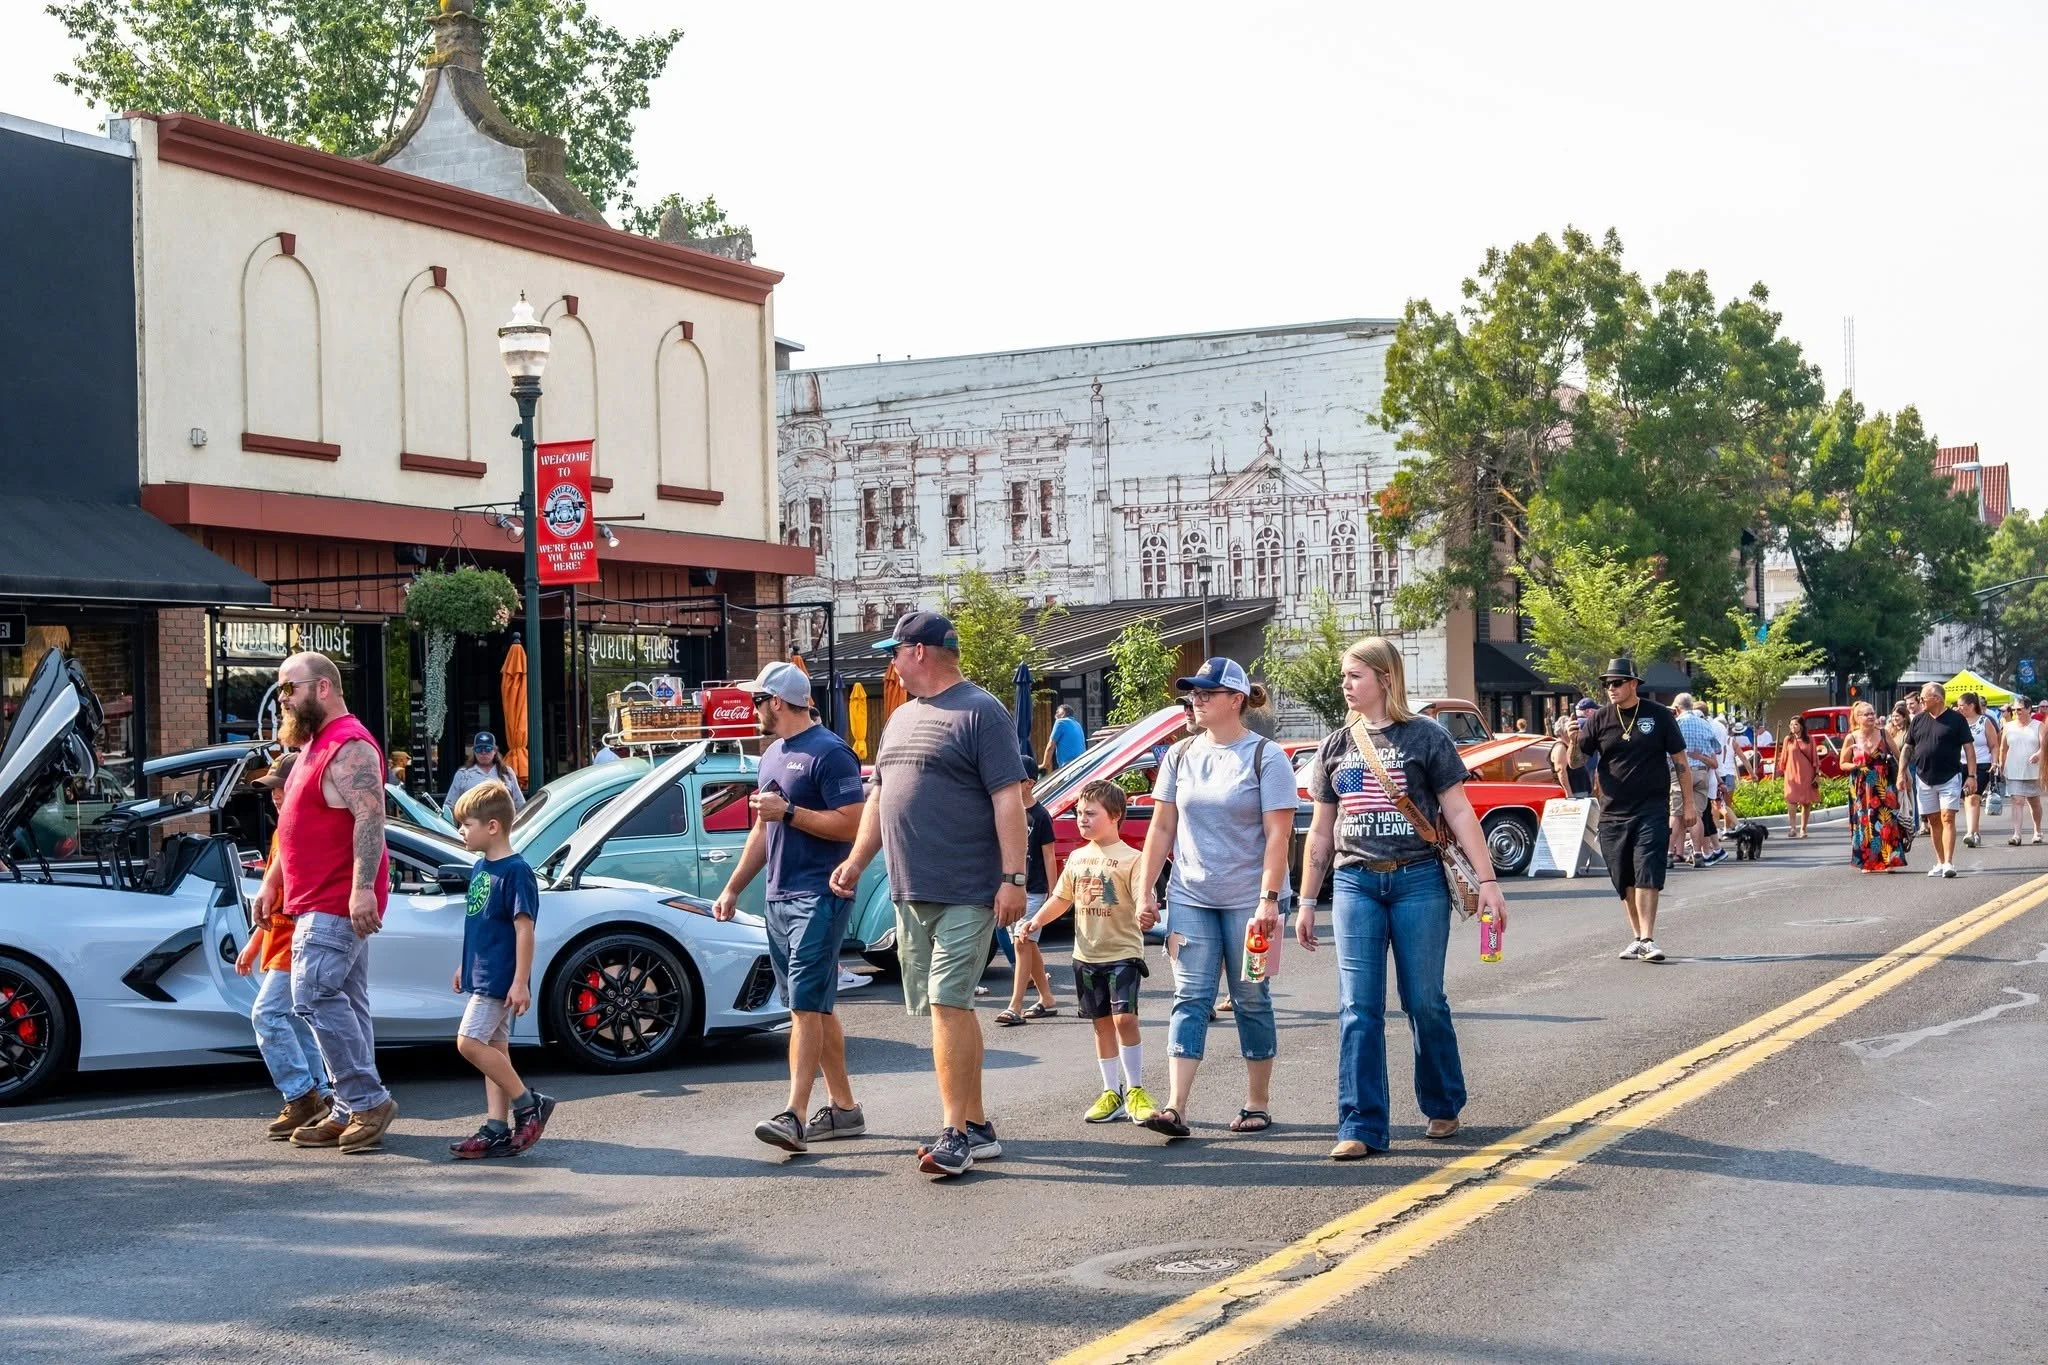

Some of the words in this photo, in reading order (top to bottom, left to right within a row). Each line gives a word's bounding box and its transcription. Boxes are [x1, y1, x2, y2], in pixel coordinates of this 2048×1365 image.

[541, 451, 590, 466] WELCOME
[558, 467, 571, 478] TO
[539, 543, 567, 554] WE'RE
[569, 541, 594, 551] GLAD
[547, 552, 562, 563] YOU
[568, 551, 587, 561] ARE
[553, 560, 582, 572] HERE!
[299, 622, 351, 658] HOUSE
[589, 633, 636, 665] PUBLIC
[643, 633, 681, 664] HOUSE
[1377, 811, 1408, 823] HATER
[1341, 824, 1371, 837] WON'T
[1375, 822, 1415, 837] LEAVE
